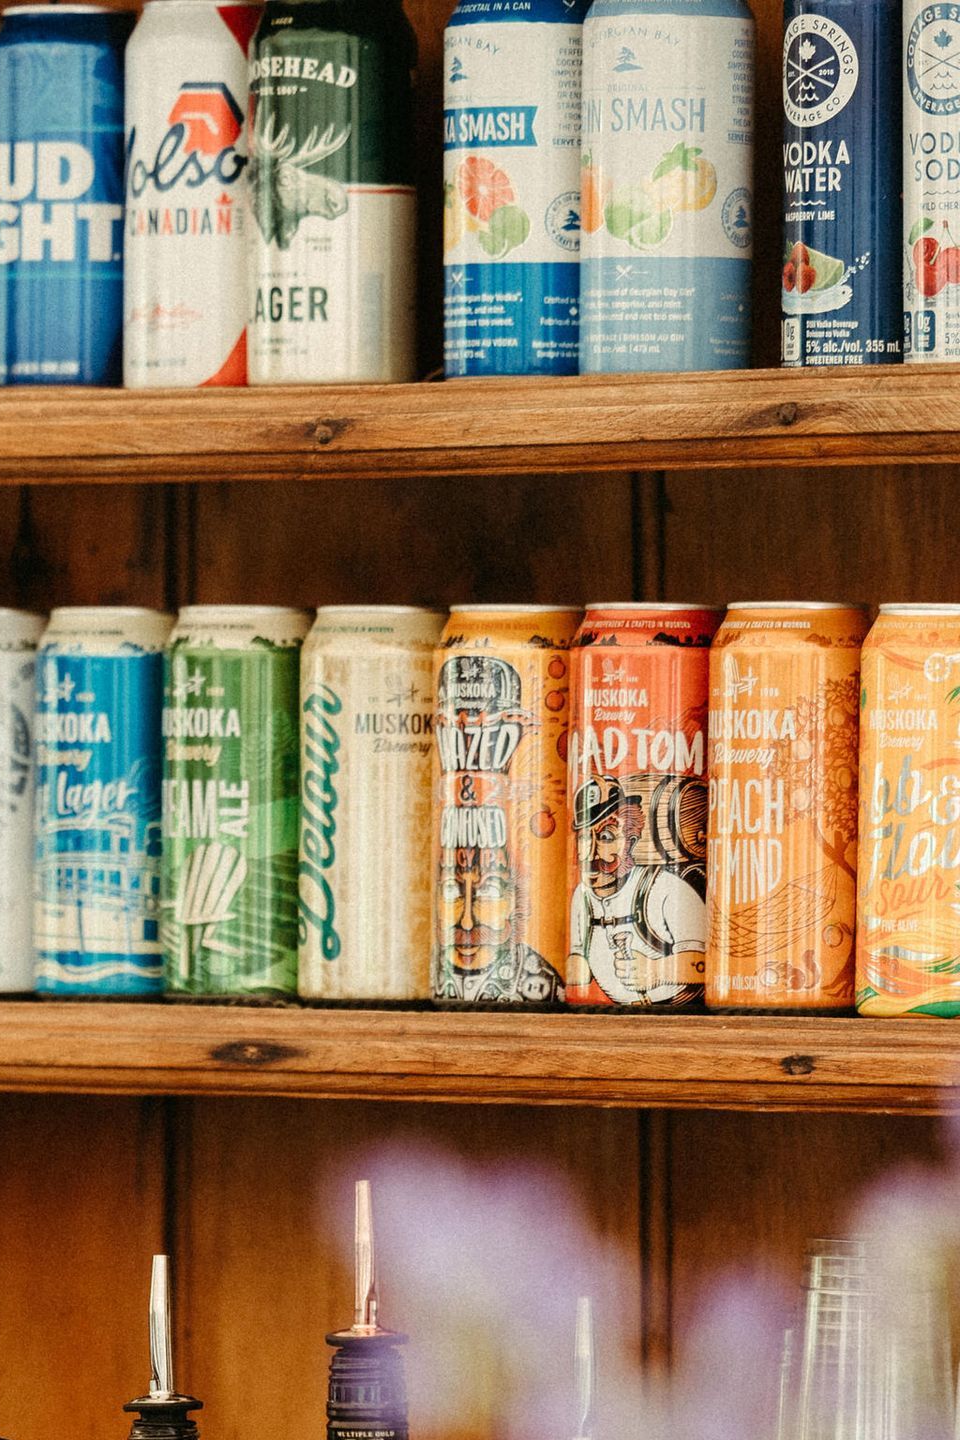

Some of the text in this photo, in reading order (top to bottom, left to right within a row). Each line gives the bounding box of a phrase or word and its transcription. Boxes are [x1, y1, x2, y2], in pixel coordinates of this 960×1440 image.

[493, 2, 531, 11] IN CAN
[476, 40, 500, 54] BAY
[812, 20, 854, 75] SPRINGS
[908, 6, 942, 68] COTTAGE
[459, 112, 525, 142] SMASH
[611, 97, 705, 133] SMASH
[783, 140, 850, 167] VODKA
[785, 167, 842, 193] WATER
[818, 210, 836, 221] LIME
[249, 286, 329, 324] AGER
[832, 320, 858, 330] Beverage
[806, 339, 901, 353] 5% alc./vol. 355 mL
[806, 355, 863, 365] SWEETENER FREE
[631, 620, 656, 629] CRAFTED
[584, 688, 648, 708] MUSKOKA
[595, 708, 636, 724] Brewery
[869, 709, 938, 731] MUSKOKA
[631, 728, 704, 776] TOM
[714, 743, 778, 770] Brewery
[57, 771, 138, 828] Lager
[460, 774, 476, 801] &
[219, 779, 250, 839] ALE
[708, 778, 784, 835] PEACH
[724, 838, 783, 906] MIND
[875, 874, 951, 918] Sour
